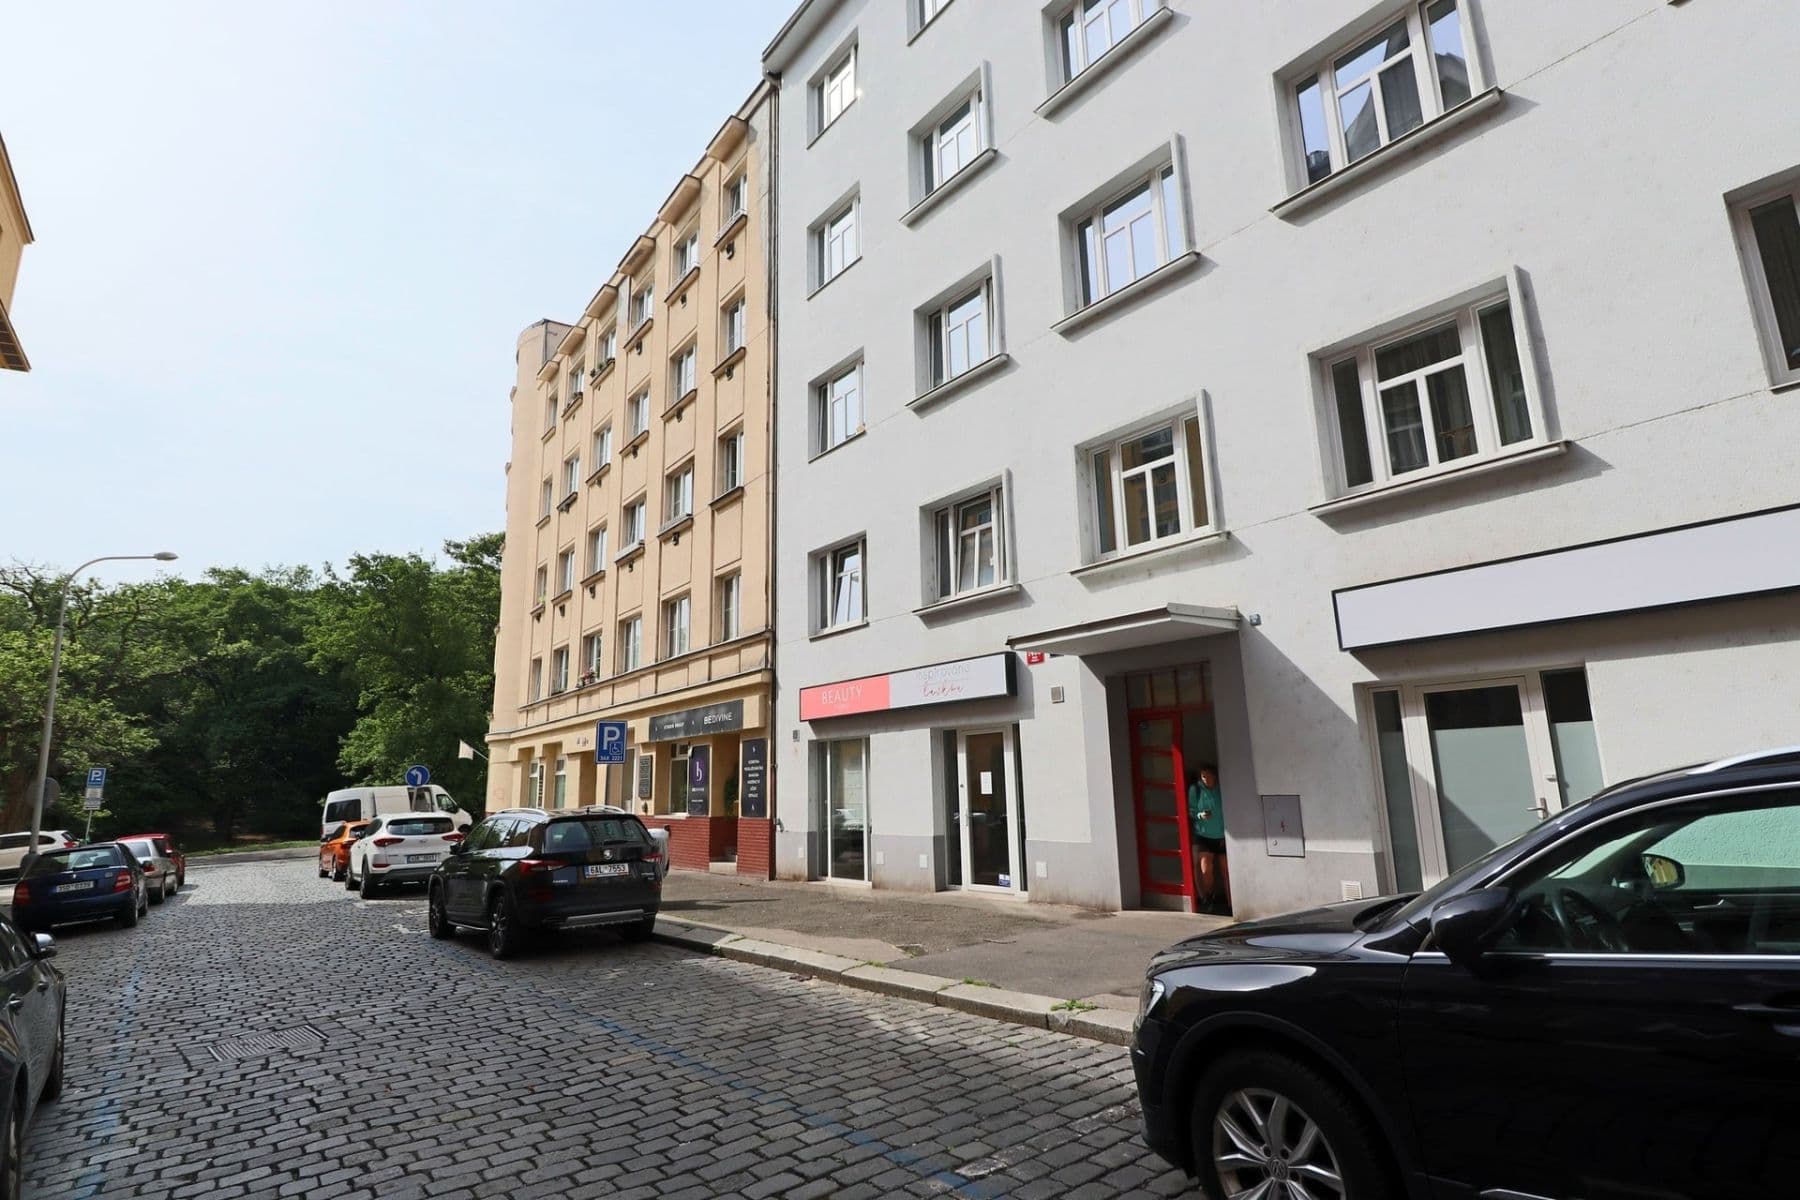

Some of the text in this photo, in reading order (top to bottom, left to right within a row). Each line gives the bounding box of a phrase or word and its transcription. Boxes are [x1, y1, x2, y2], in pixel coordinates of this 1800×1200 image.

[822, 685, 864, 705] BEAUTY
[703, 711, 734, 725] BEDIVINE
[603, 726, 620, 750] P
[91, 770, 102, 781] P
